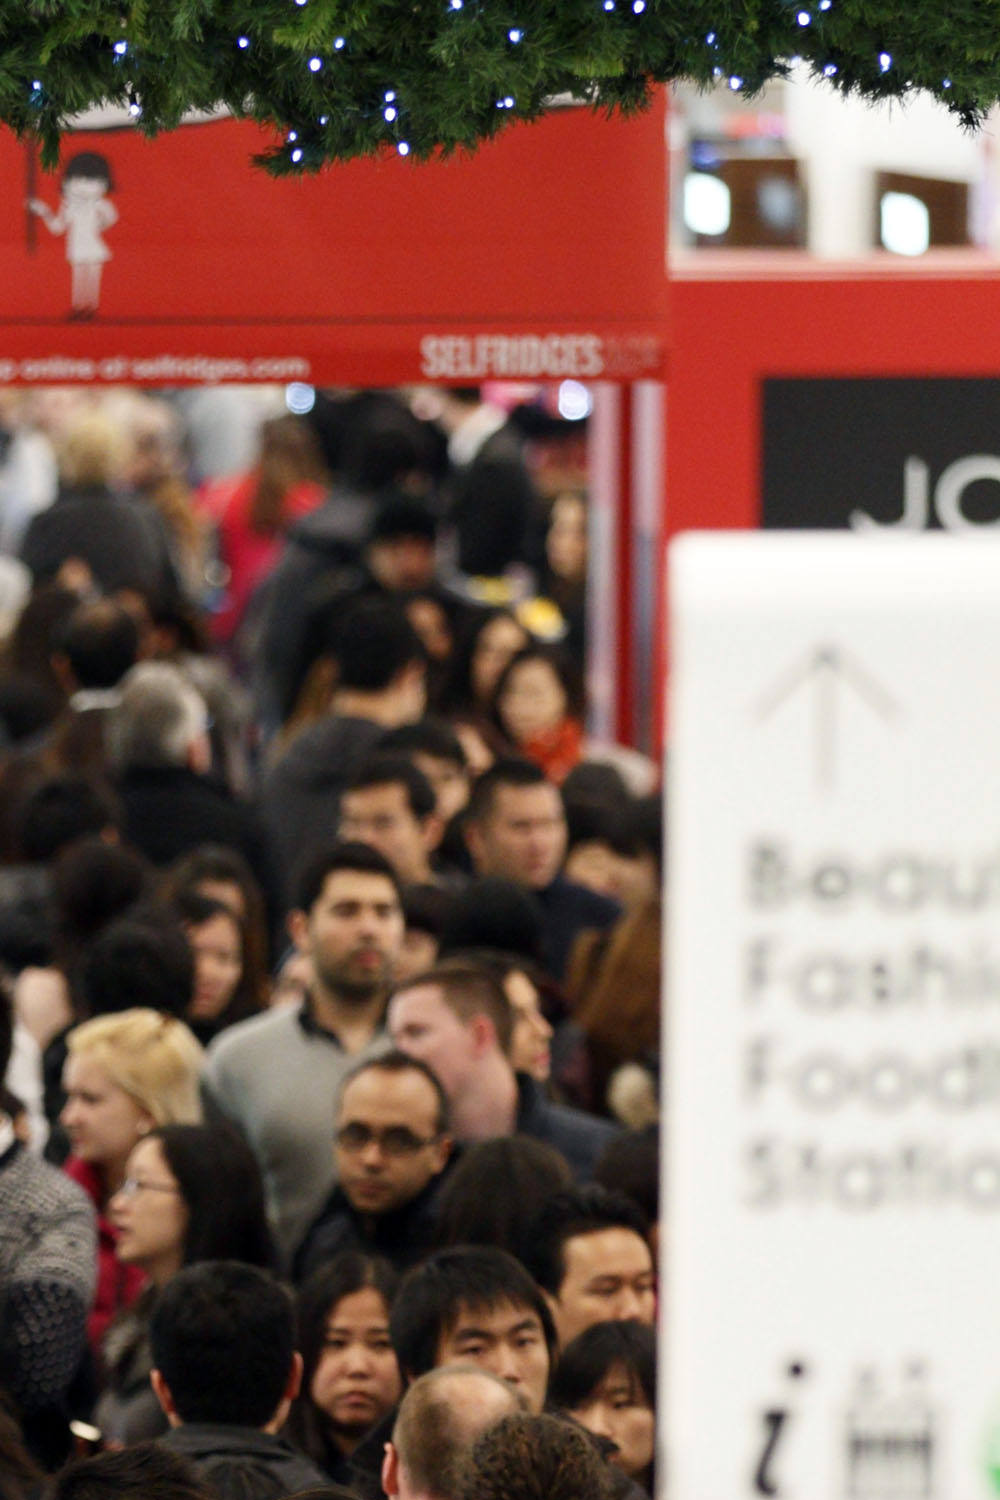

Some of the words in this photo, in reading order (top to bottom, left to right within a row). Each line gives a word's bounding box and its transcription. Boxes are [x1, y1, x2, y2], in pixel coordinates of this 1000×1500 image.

[20, 355, 96, 381] online
[100, 356, 127, 381] at
[130, 355, 310, 384] selfridges.com
[420, 333, 603, 378] SELFRIDGES
